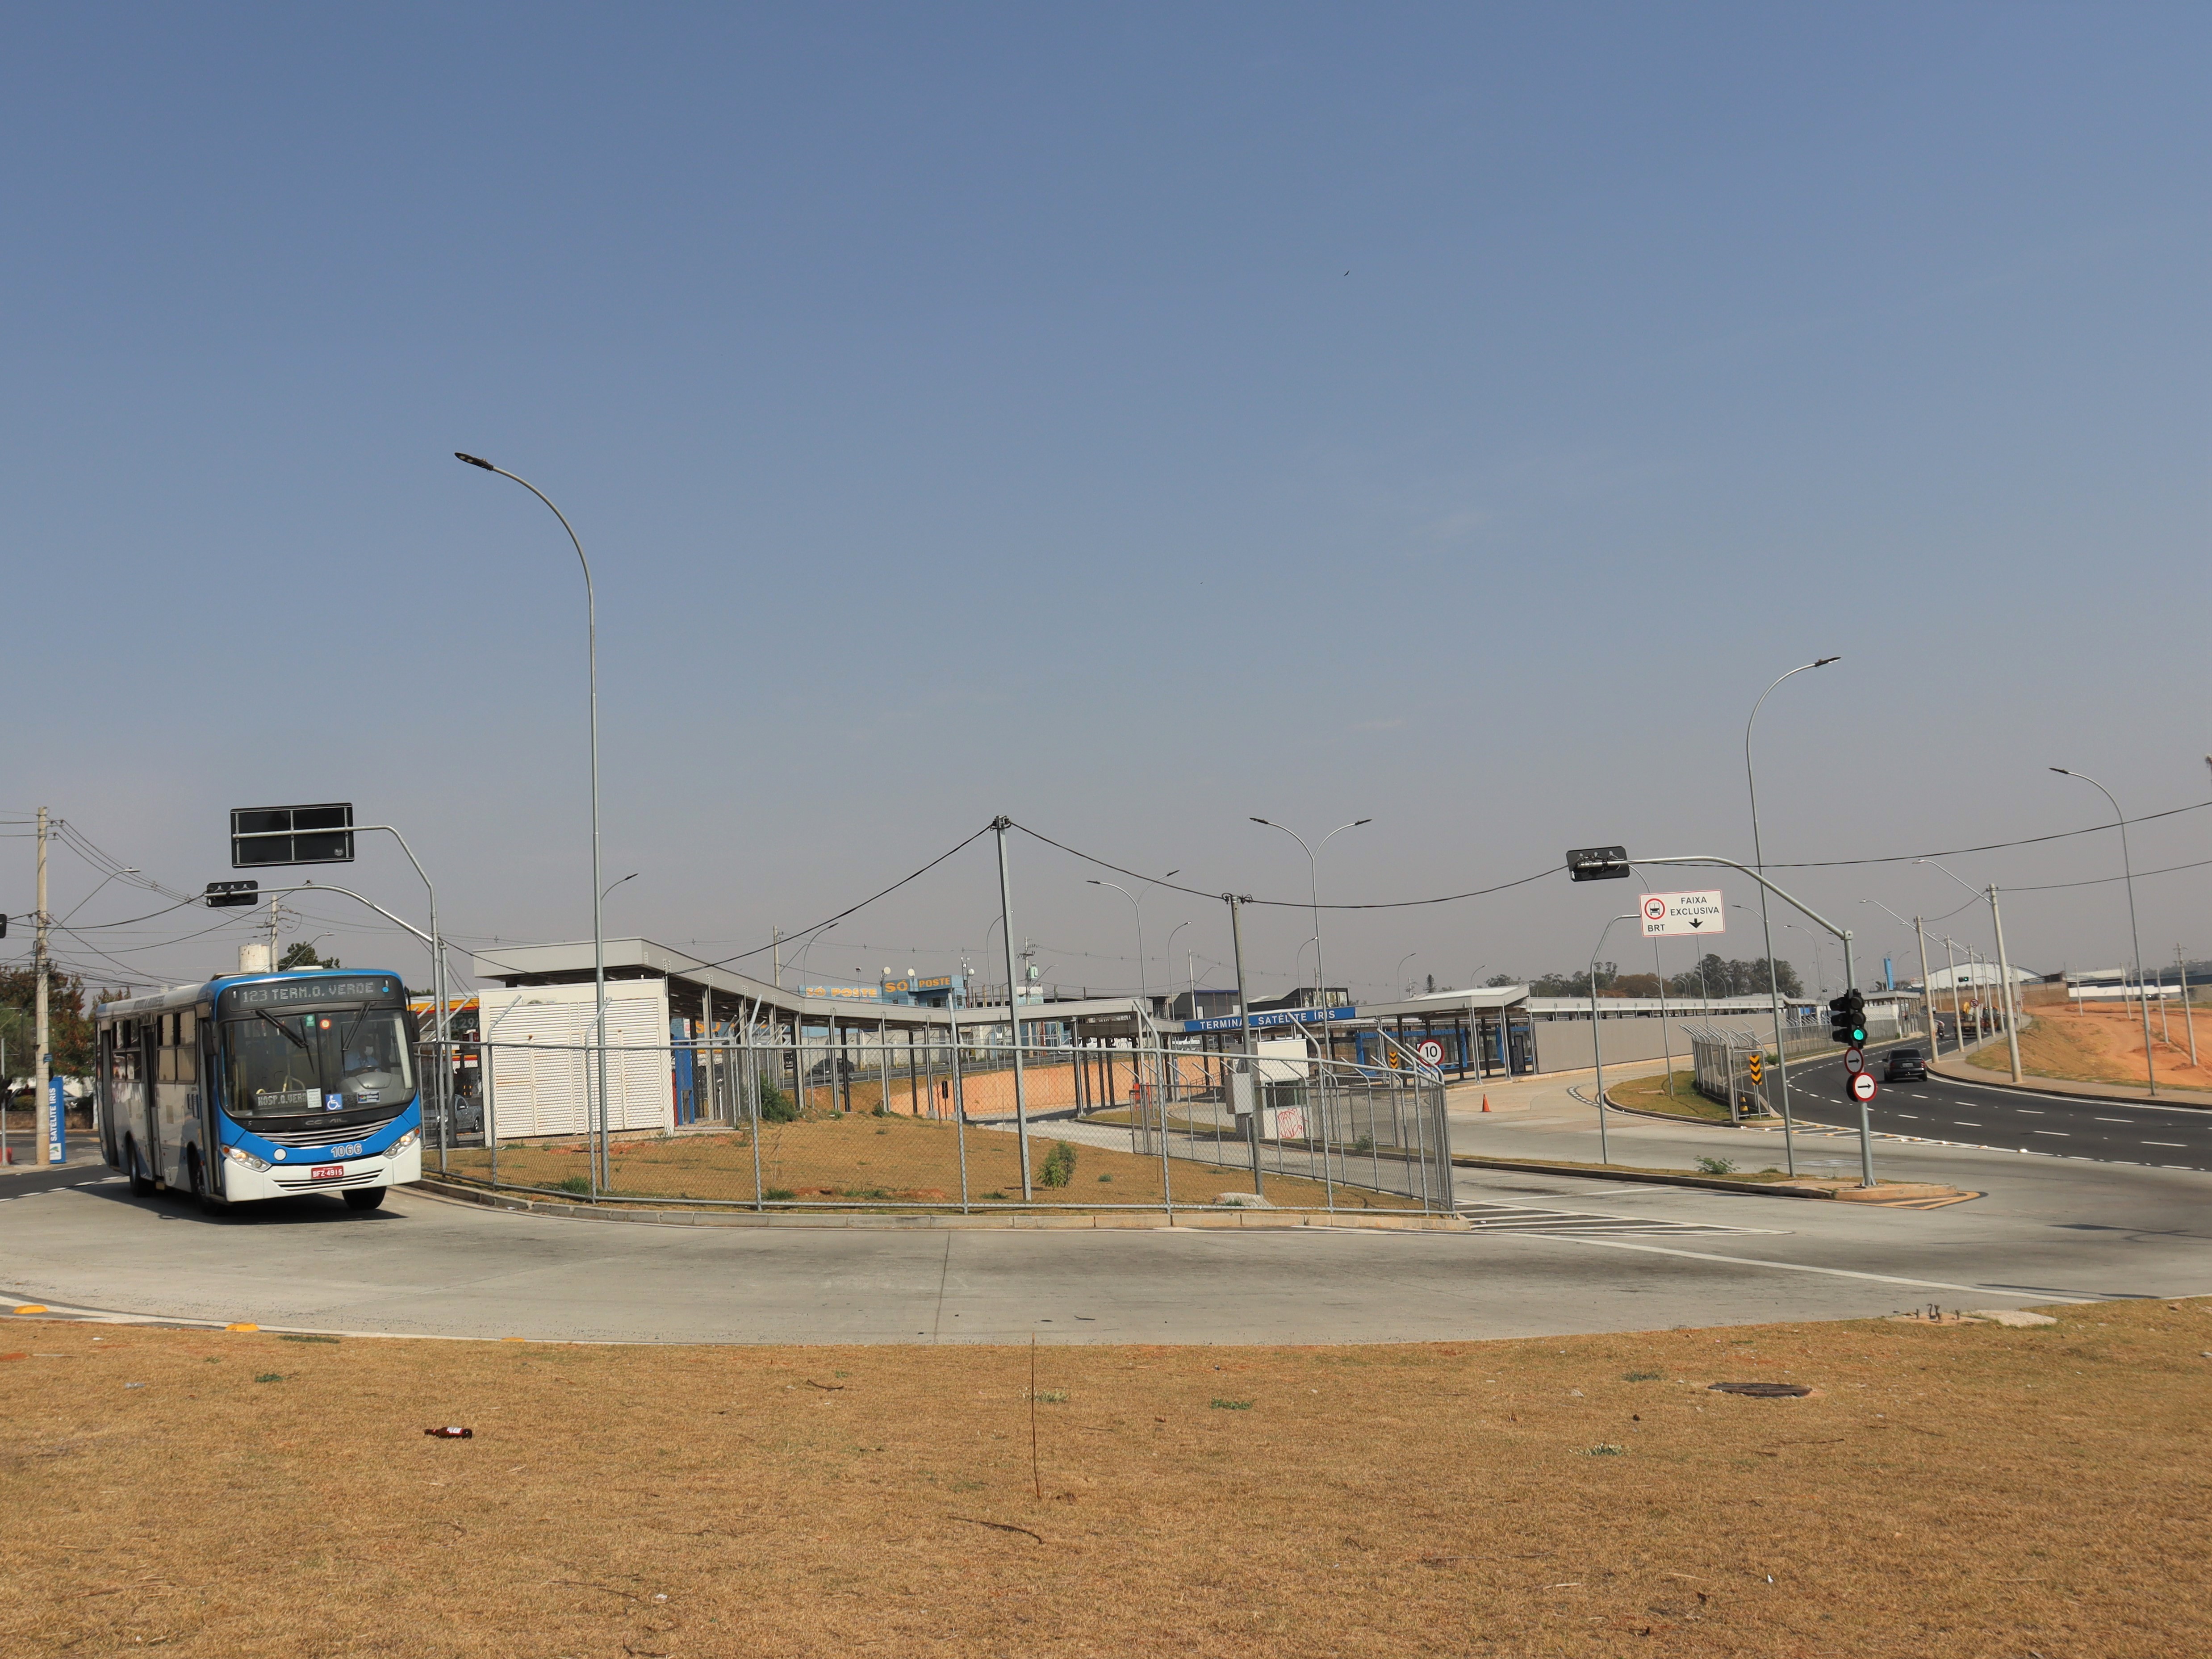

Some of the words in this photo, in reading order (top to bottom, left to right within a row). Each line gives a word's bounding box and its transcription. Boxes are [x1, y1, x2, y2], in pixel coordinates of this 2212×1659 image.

[1681, 896, 1707, 904] FAIXA
[1670, 907, 1719, 916] EXCLUSIVA
[243, 990, 268, 1002] 123
[329, 982, 374, 995] VERDE
[806, 986, 826, 997] SÓ
[831, 988, 877, 997] POSTE
[885, 980, 908, 993] SÓ
[919, 978, 950, 988] POSTE
[1200, 1019, 1251, 1029] TERMIN
[1258, 1013, 1307, 1025] SATÉLTE
[1425, 1046, 1438, 1058] 10
[331, 1143, 363, 1158] 1066
